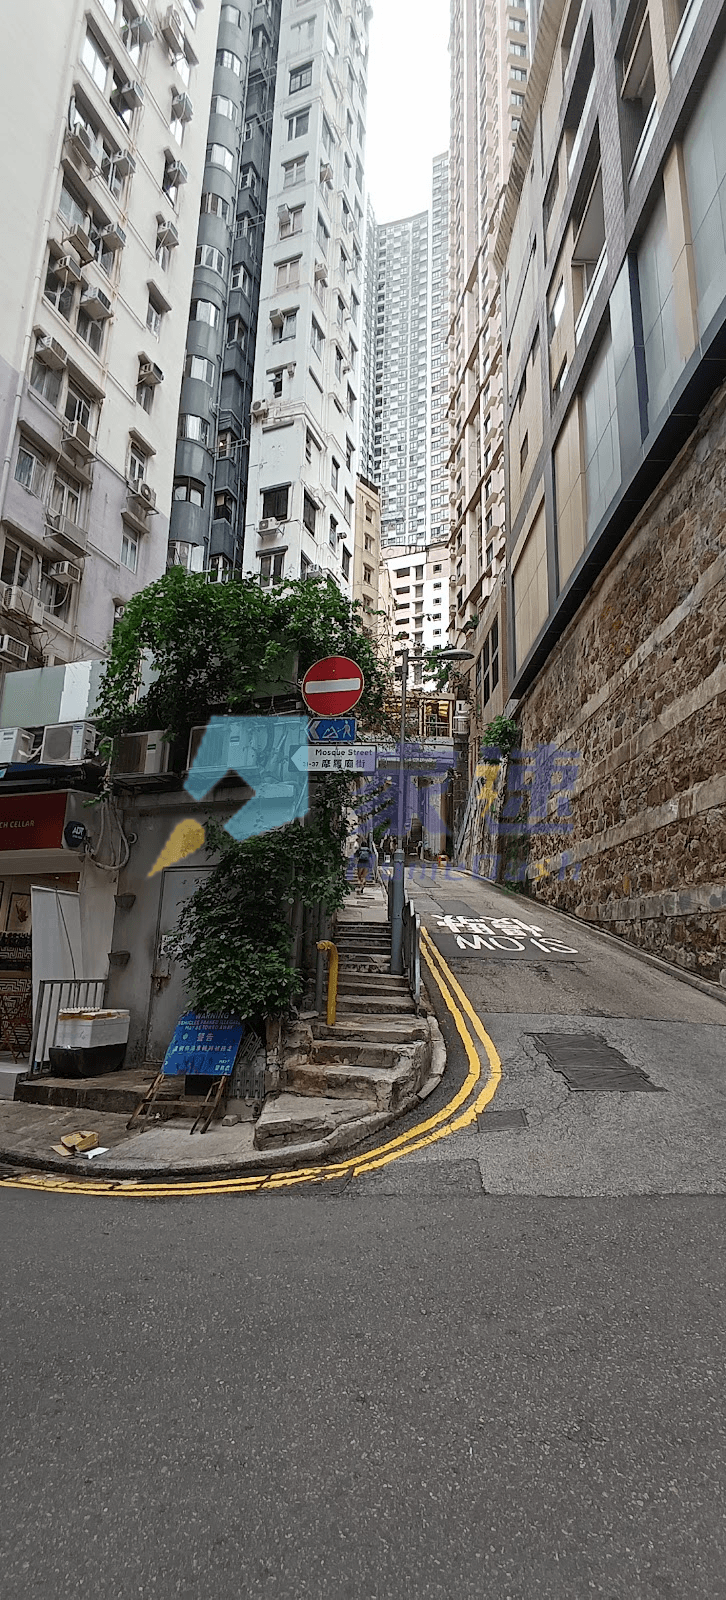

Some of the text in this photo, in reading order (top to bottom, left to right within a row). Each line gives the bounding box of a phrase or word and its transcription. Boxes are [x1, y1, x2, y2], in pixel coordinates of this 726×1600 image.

[315, 749, 373, 757] Mosque Street
[321, 759, 366, 769] 摩羅廟街
[9, 819, 35, 829] CELLAR
[72, 826, 84, 836] ADT
[454, 934, 579, 955] SLOW
